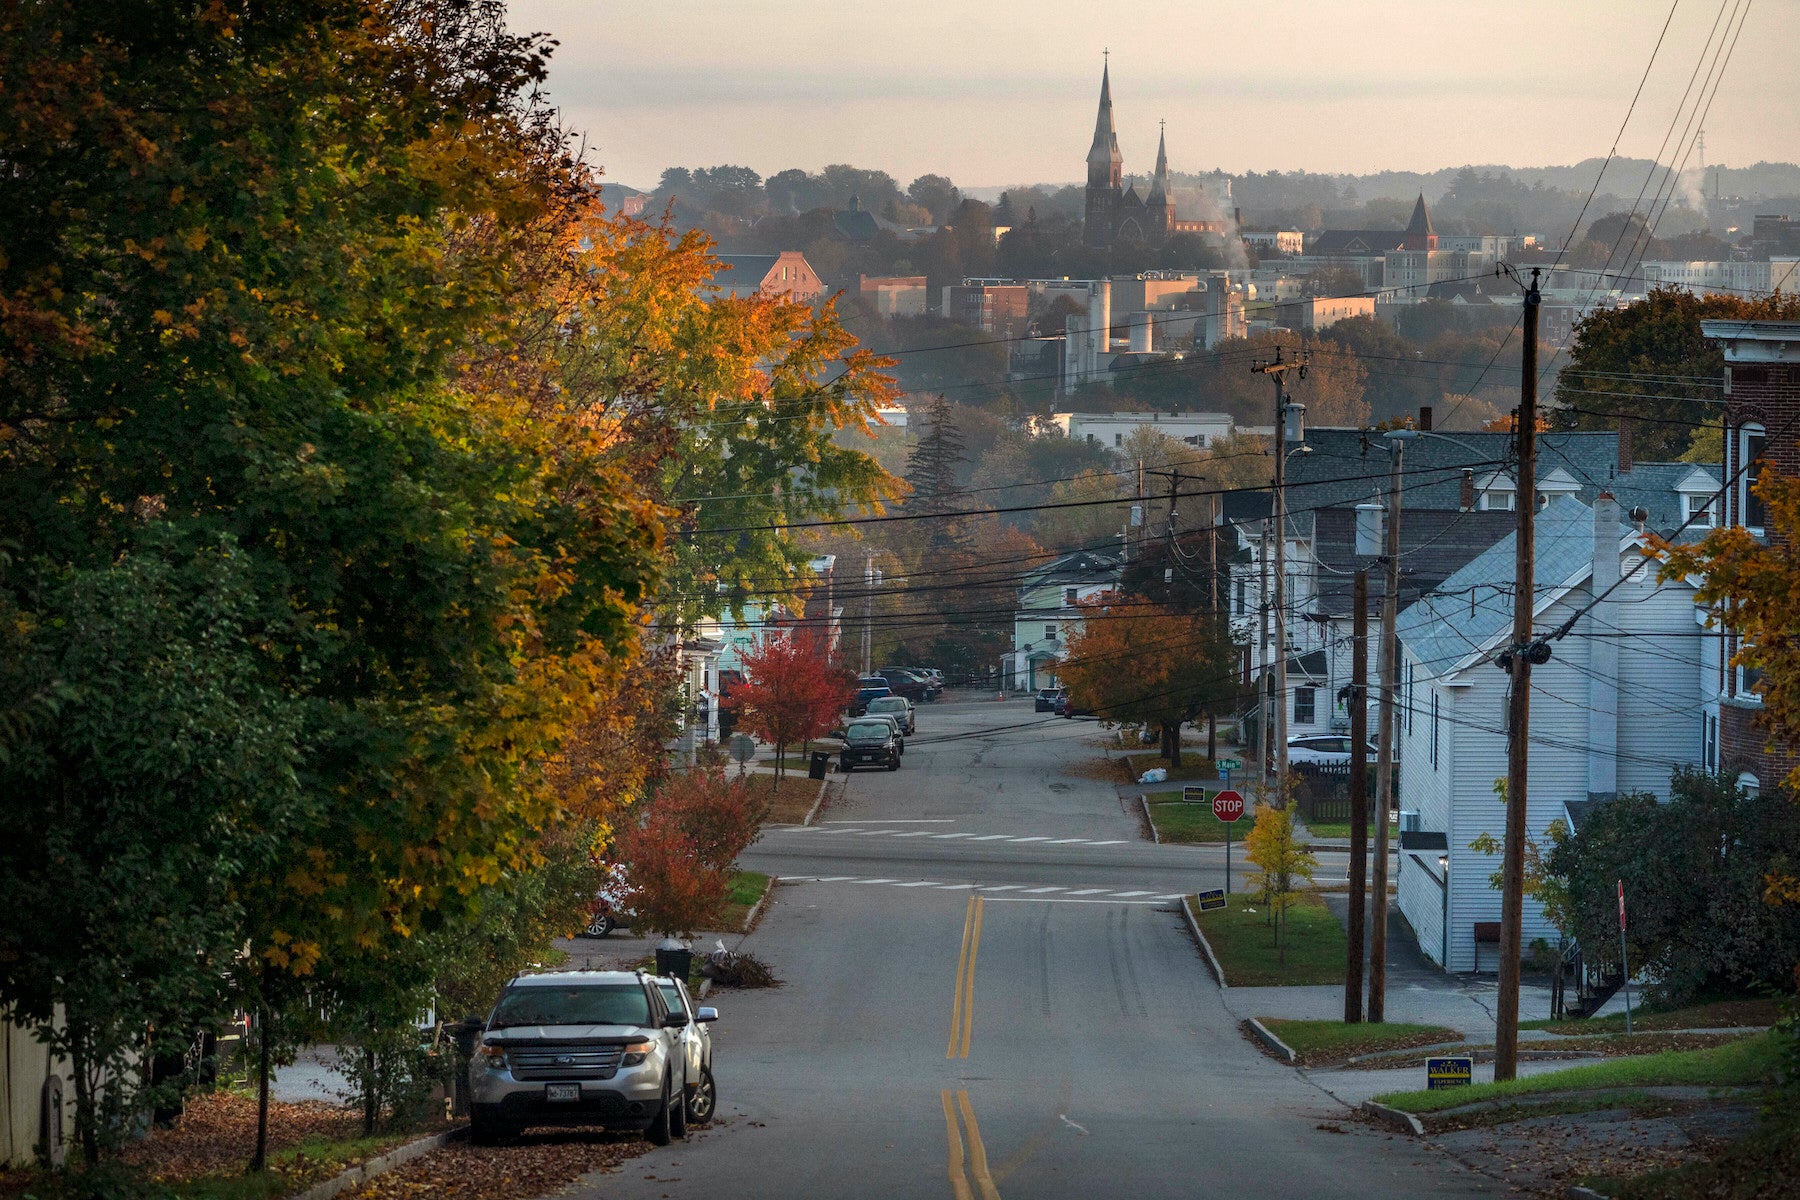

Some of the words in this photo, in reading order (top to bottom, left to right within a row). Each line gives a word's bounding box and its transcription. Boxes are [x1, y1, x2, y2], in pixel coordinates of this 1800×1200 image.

[1217, 761, 1221, 769] S
[1222, 760, 1236, 769] Main
[1215, 800, 1242, 812] STOP
[1430, 1066, 1469, 1074] WALKER
